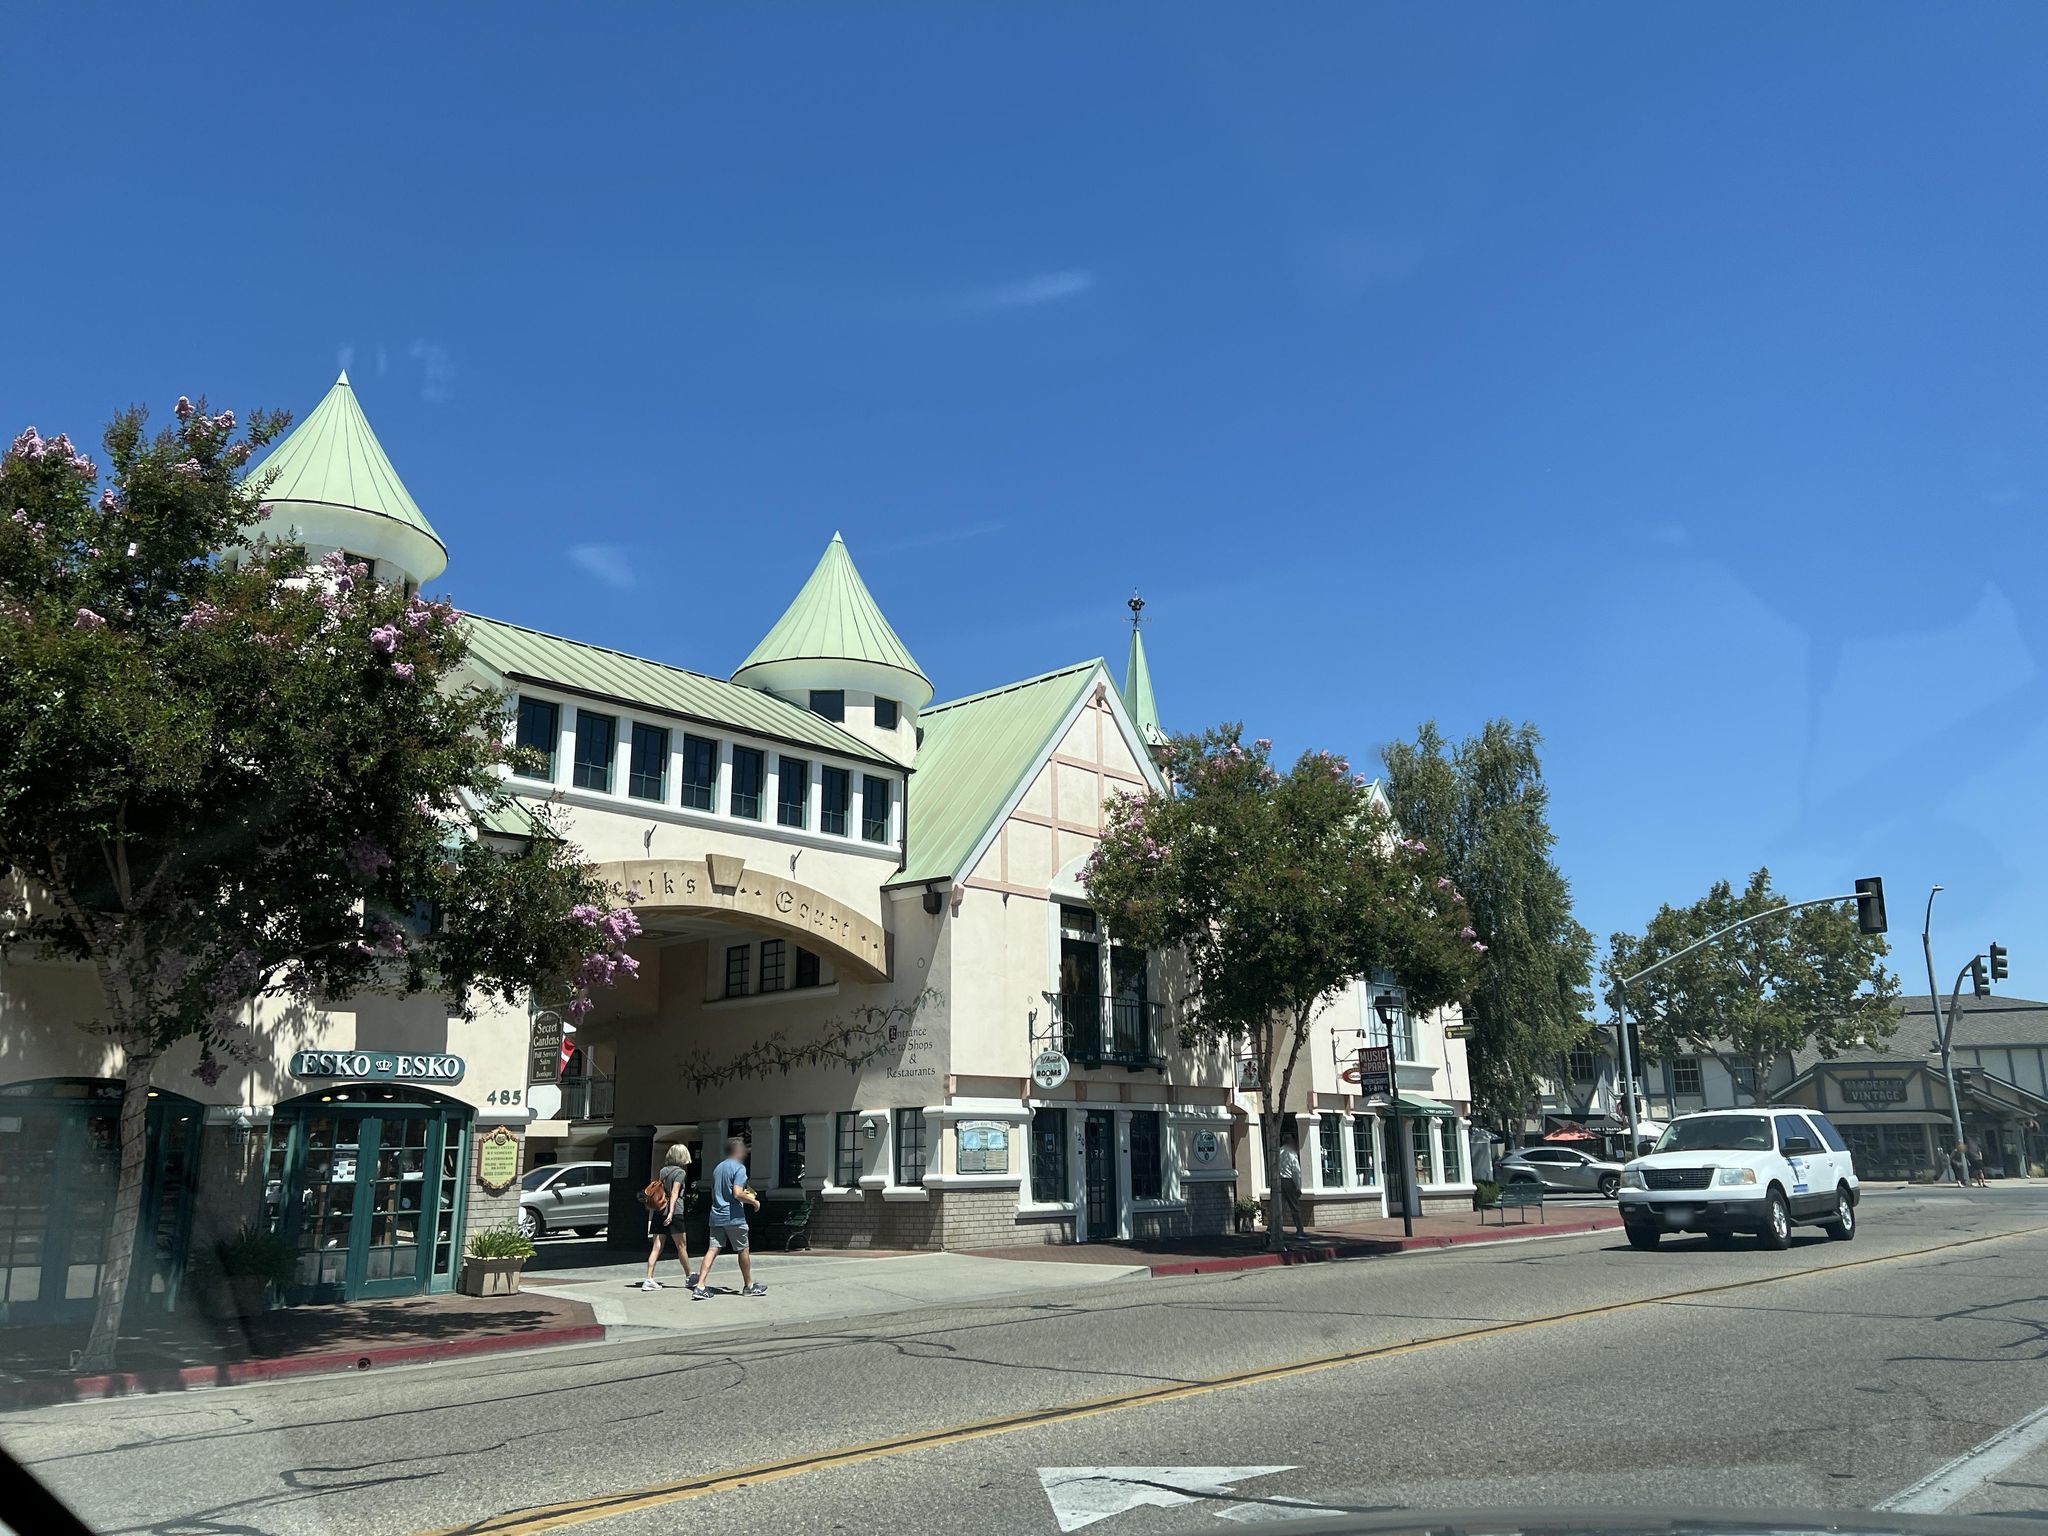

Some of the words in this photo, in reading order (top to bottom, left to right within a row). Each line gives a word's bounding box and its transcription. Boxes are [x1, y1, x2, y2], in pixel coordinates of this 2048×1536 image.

[775, 890, 850, 937] Court
[537, 1023, 558, 1034] Secret
[889, 1025, 927, 1042] Entrance
[533, 1035, 560, 1047] Gardens
[897, 1043, 906, 1052] to
[907, 1039, 933, 1052] Shops
[909, 1053, 917, 1064] &
[1360, 1050, 1387, 1062] MUSIC
[300, 1053, 372, 1076] ESKO
[395, 1056, 460, 1078] ESKO
[1368, 1061, 1387, 1072] PARK
[886, 1066, 936, 1079] Restaurants
[1036, 1069, 1062, 1077] ROOMS
[486, 1089, 522, 1106] 485
[1851, 1090, 1901, 1100] VINTAGE
